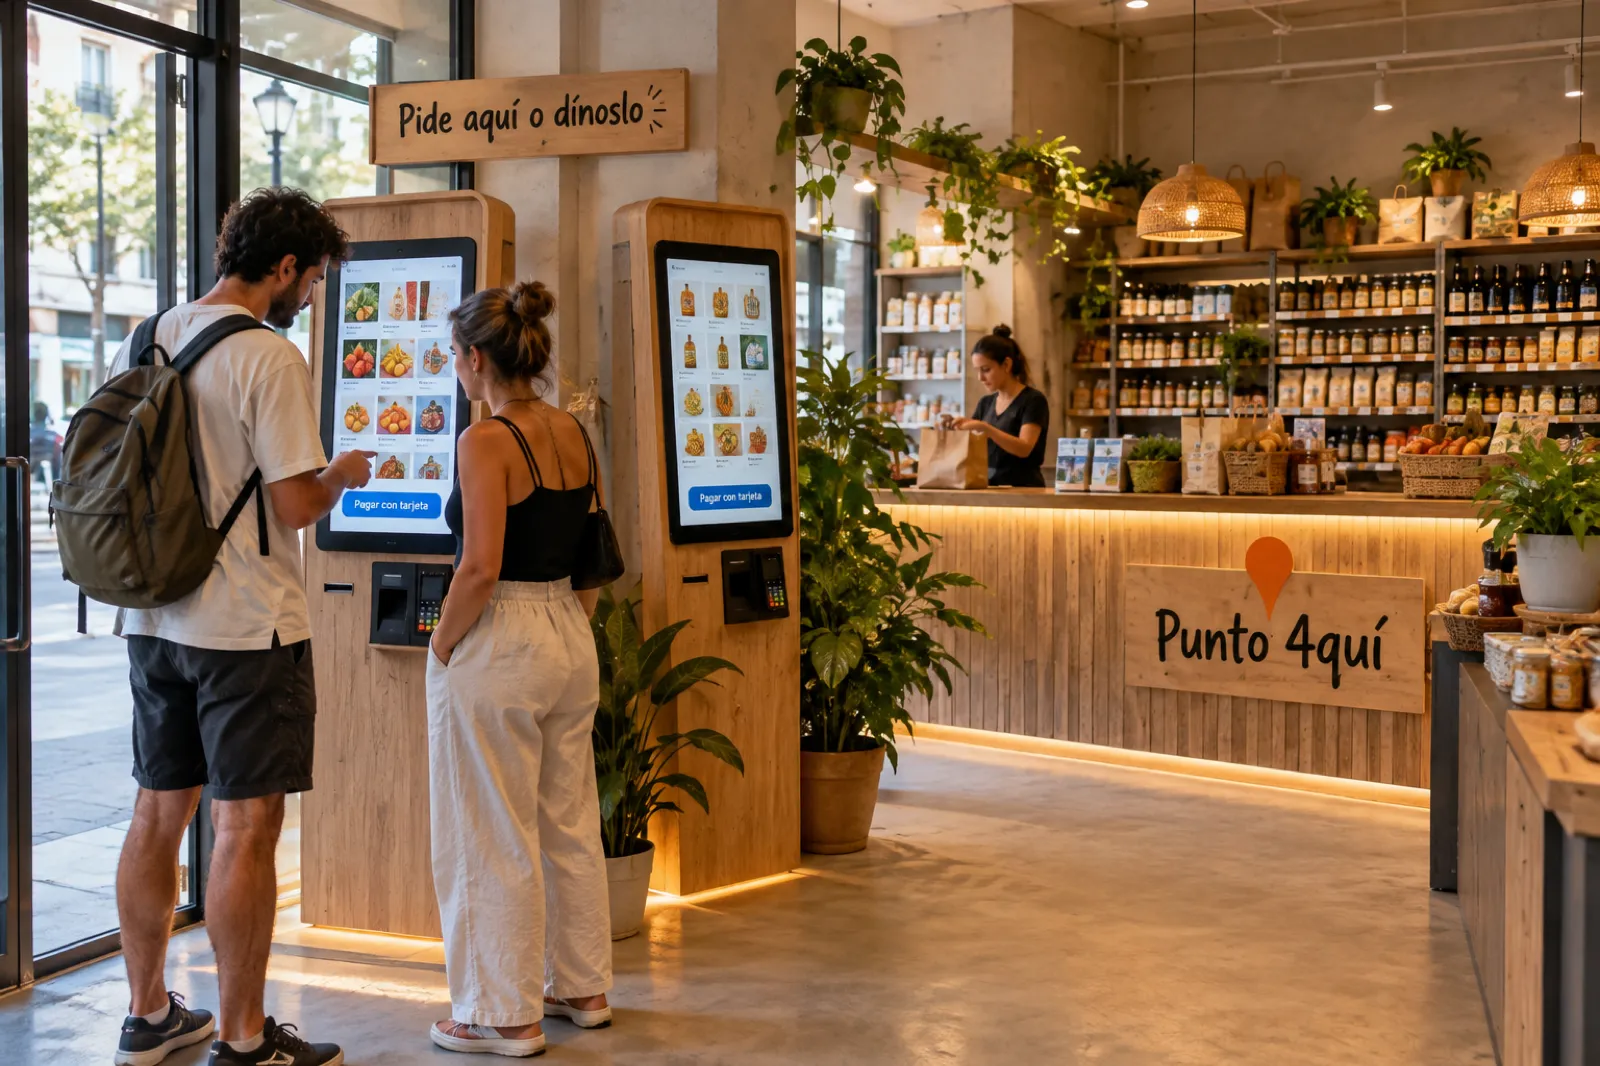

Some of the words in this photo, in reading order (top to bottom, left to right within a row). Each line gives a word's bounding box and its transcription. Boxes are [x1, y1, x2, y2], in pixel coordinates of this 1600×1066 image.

[399, 101, 452, 138] Pide
[464, 98, 521, 143] aquí
[530, 107, 544, 128] o
[554, 90, 644, 128] dínoslo
[354, 499, 379, 511] Pagar
[381, 501, 397, 509] con
[400, 501, 428, 512] tarjeta
[700, 493, 721, 505] Pagar
[723, 493, 736, 501] con
[738, 491, 762, 503] tarjeta
[1155, 608, 1269, 664] Punto
